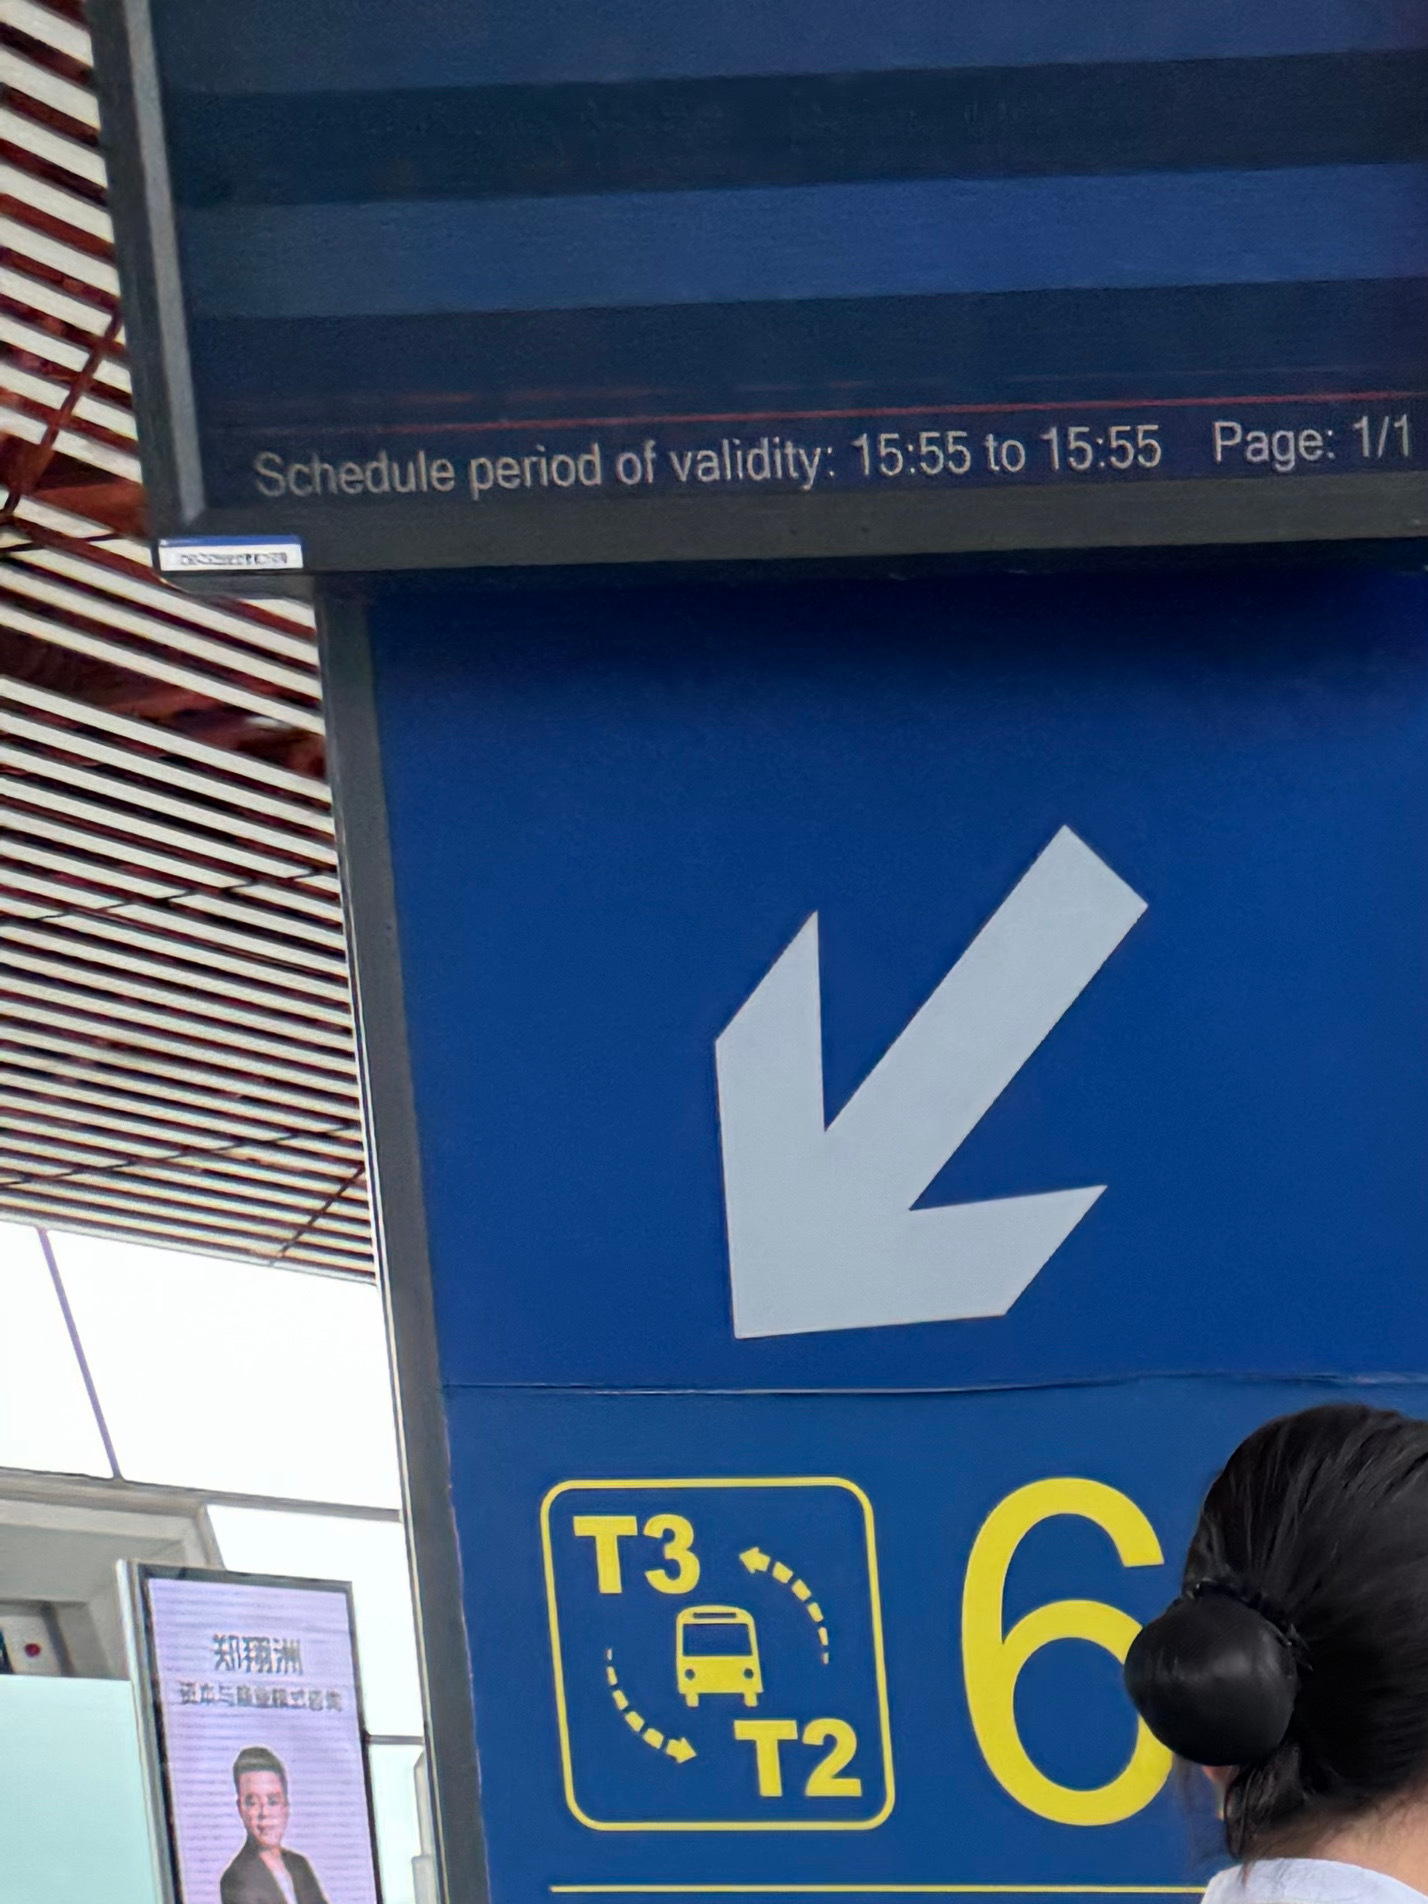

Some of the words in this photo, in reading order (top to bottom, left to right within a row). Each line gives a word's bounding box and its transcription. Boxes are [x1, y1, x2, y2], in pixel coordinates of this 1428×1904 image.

[252, 449, 455, 498] Schedule
[469, 443, 601, 500] period
[615, 440, 656, 485] of
[668, 436, 836, 491] validity:
[852, 430, 971, 477] 15:55
[985, 432, 1026, 474] to
[1041, 424, 1162, 472] 15:55
[1212, 420, 1336, 473] Page:
[1352, 414, 1413, 460] 1/1
[573, 1514, 701, 1595] T3
[733, 1718, 863, 1798] T2
